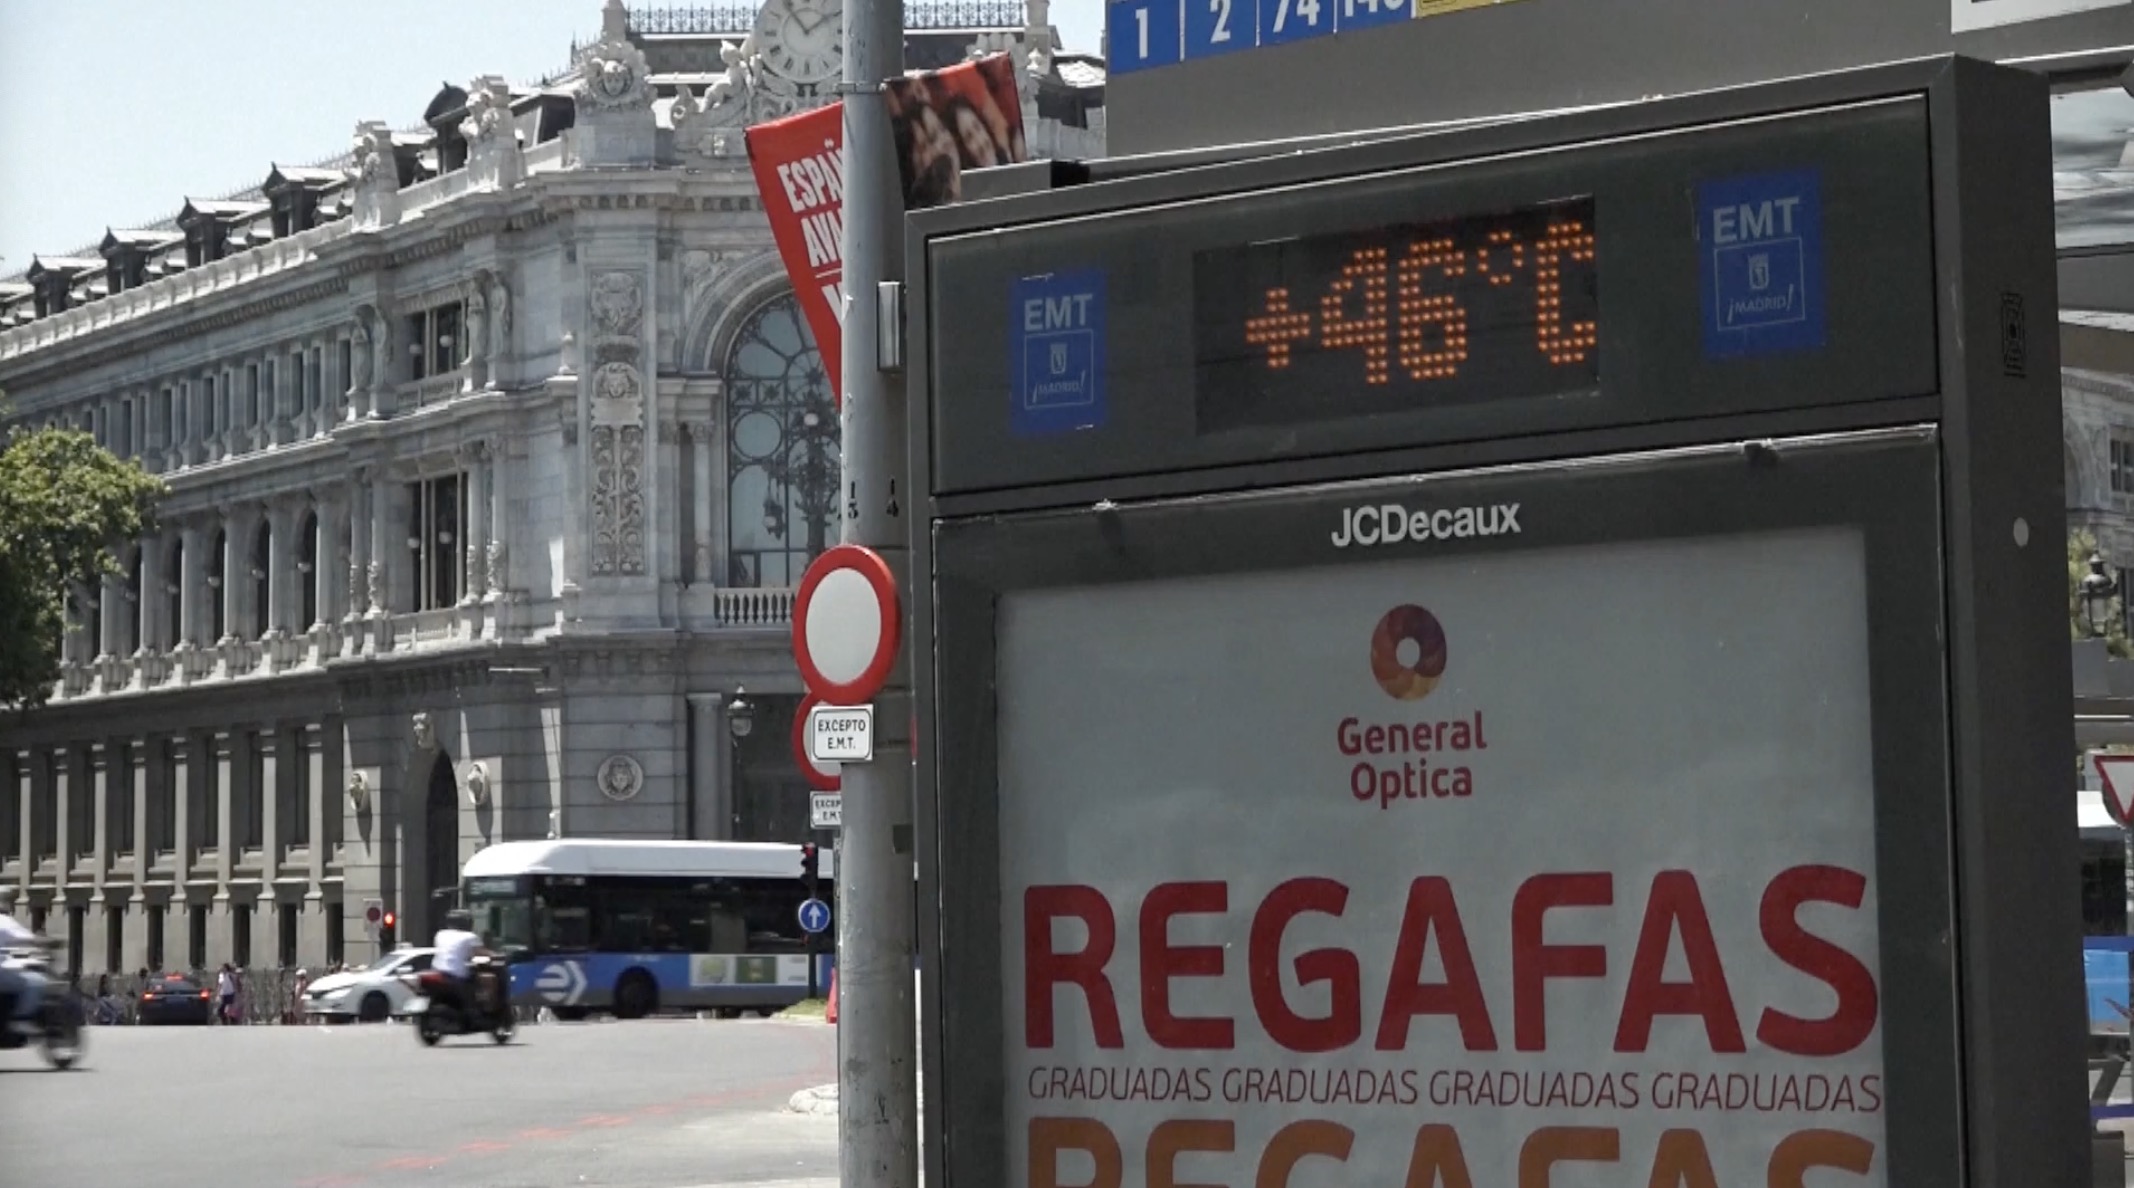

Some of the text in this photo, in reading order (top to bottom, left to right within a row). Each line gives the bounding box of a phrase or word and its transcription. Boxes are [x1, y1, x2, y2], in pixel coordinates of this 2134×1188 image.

[1135, 7, 1149, 59] 1
[1210, 0, 1231, 43] 2
[1712, 196, 1800, 244] EMT
[1024, 293, 1094, 331] EMT
[1331, 502, 1522, 547] JCDecaux
[818, 719, 867, 732] EXCEPTO
[827, 737, 857, 749] E.M.T.
[1337, 710, 1488, 756] General
[1350, 757, 1474, 810] Optica
[1024, 863, 1879, 1058] REGAFAS
[1028, 1066, 1882, 1112] GRADUADAS GRADUADAS GRADUADAS GRADUADAS
